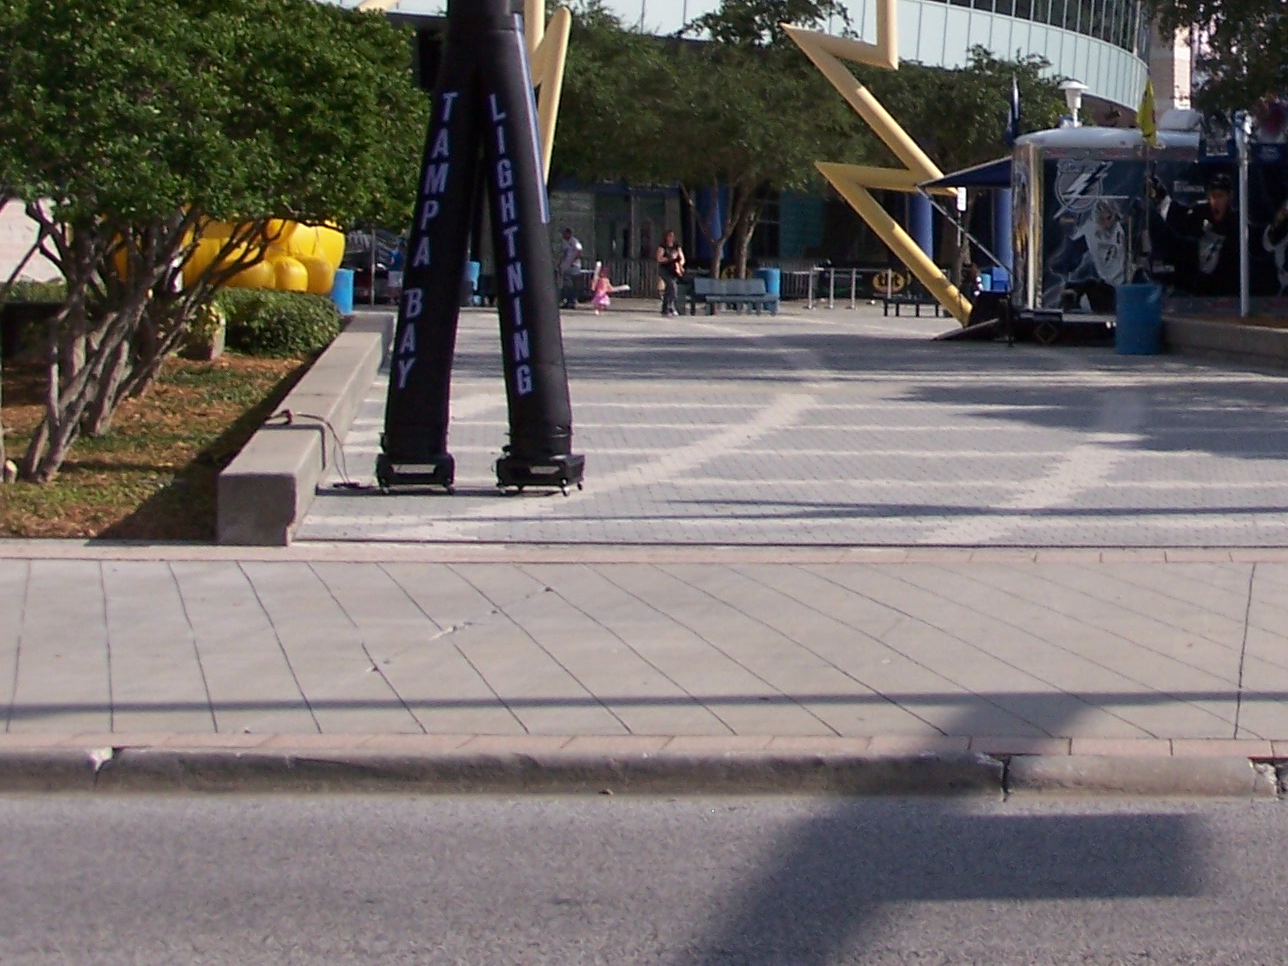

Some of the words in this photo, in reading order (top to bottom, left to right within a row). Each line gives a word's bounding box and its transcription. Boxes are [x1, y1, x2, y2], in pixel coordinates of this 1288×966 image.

[412, 92, 458, 267] TAMPA
[488, 93, 534, 396] LIGHTNING
[397, 288, 423, 389] BAY
